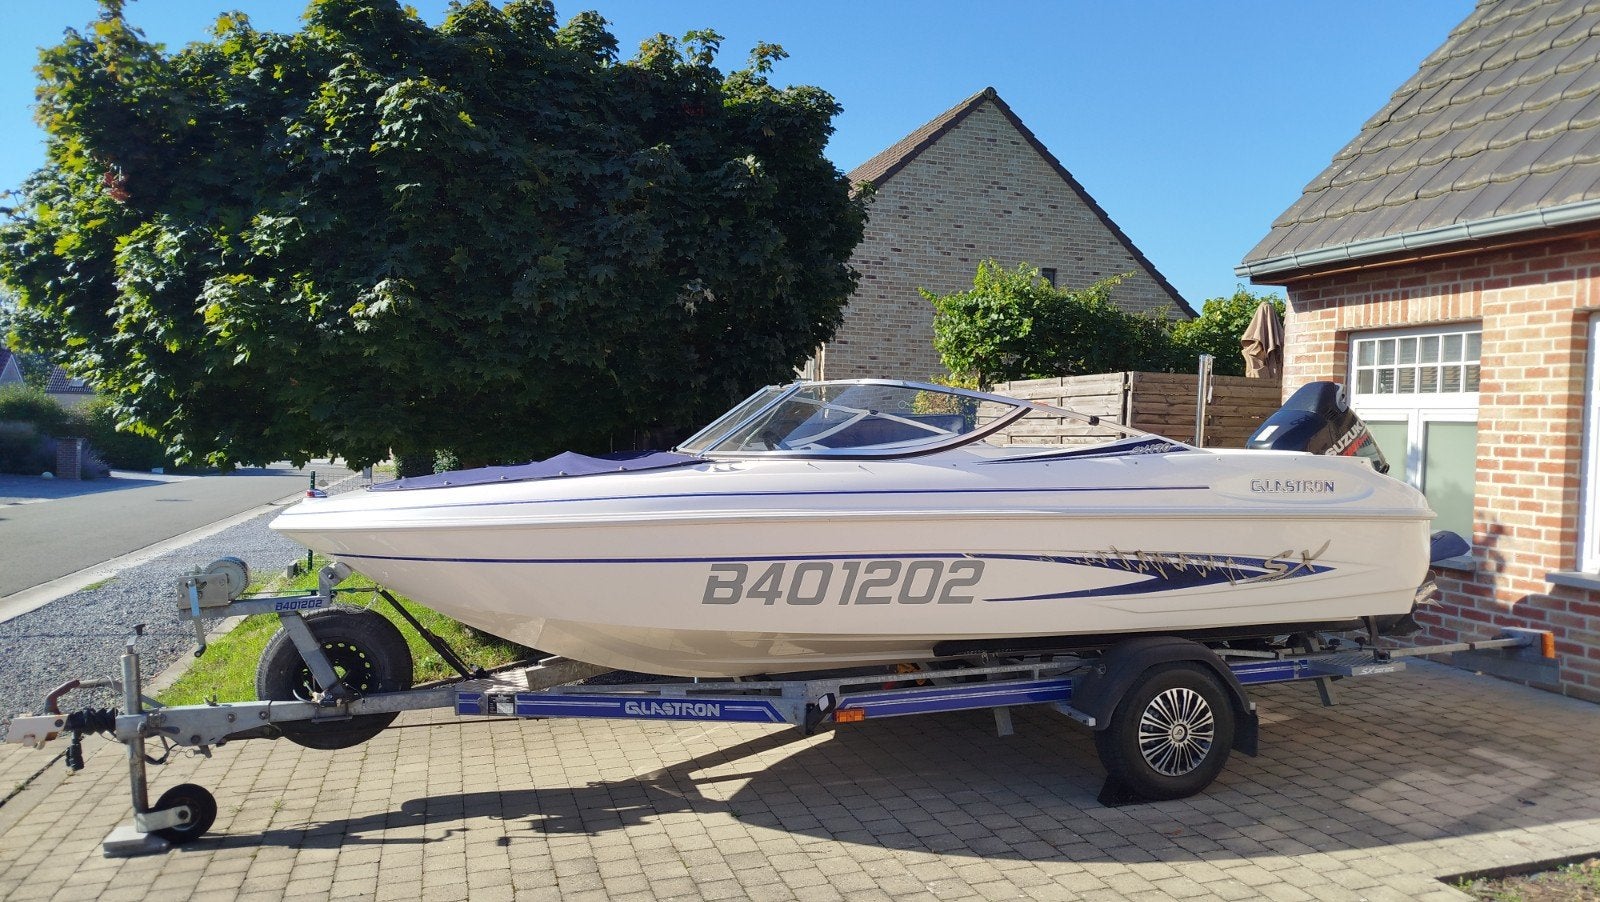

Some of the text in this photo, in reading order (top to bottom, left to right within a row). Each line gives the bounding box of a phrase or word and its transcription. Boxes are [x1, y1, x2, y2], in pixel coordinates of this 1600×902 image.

[1325, 419, 1367, 456] SUZUKI
[1251, 480, 1335, 493] GLASTRON
[701, 559, 986, 606] B401202
[275, 599, 323, 611] B401202
[624, 701, 720, 717] GLASTRON
